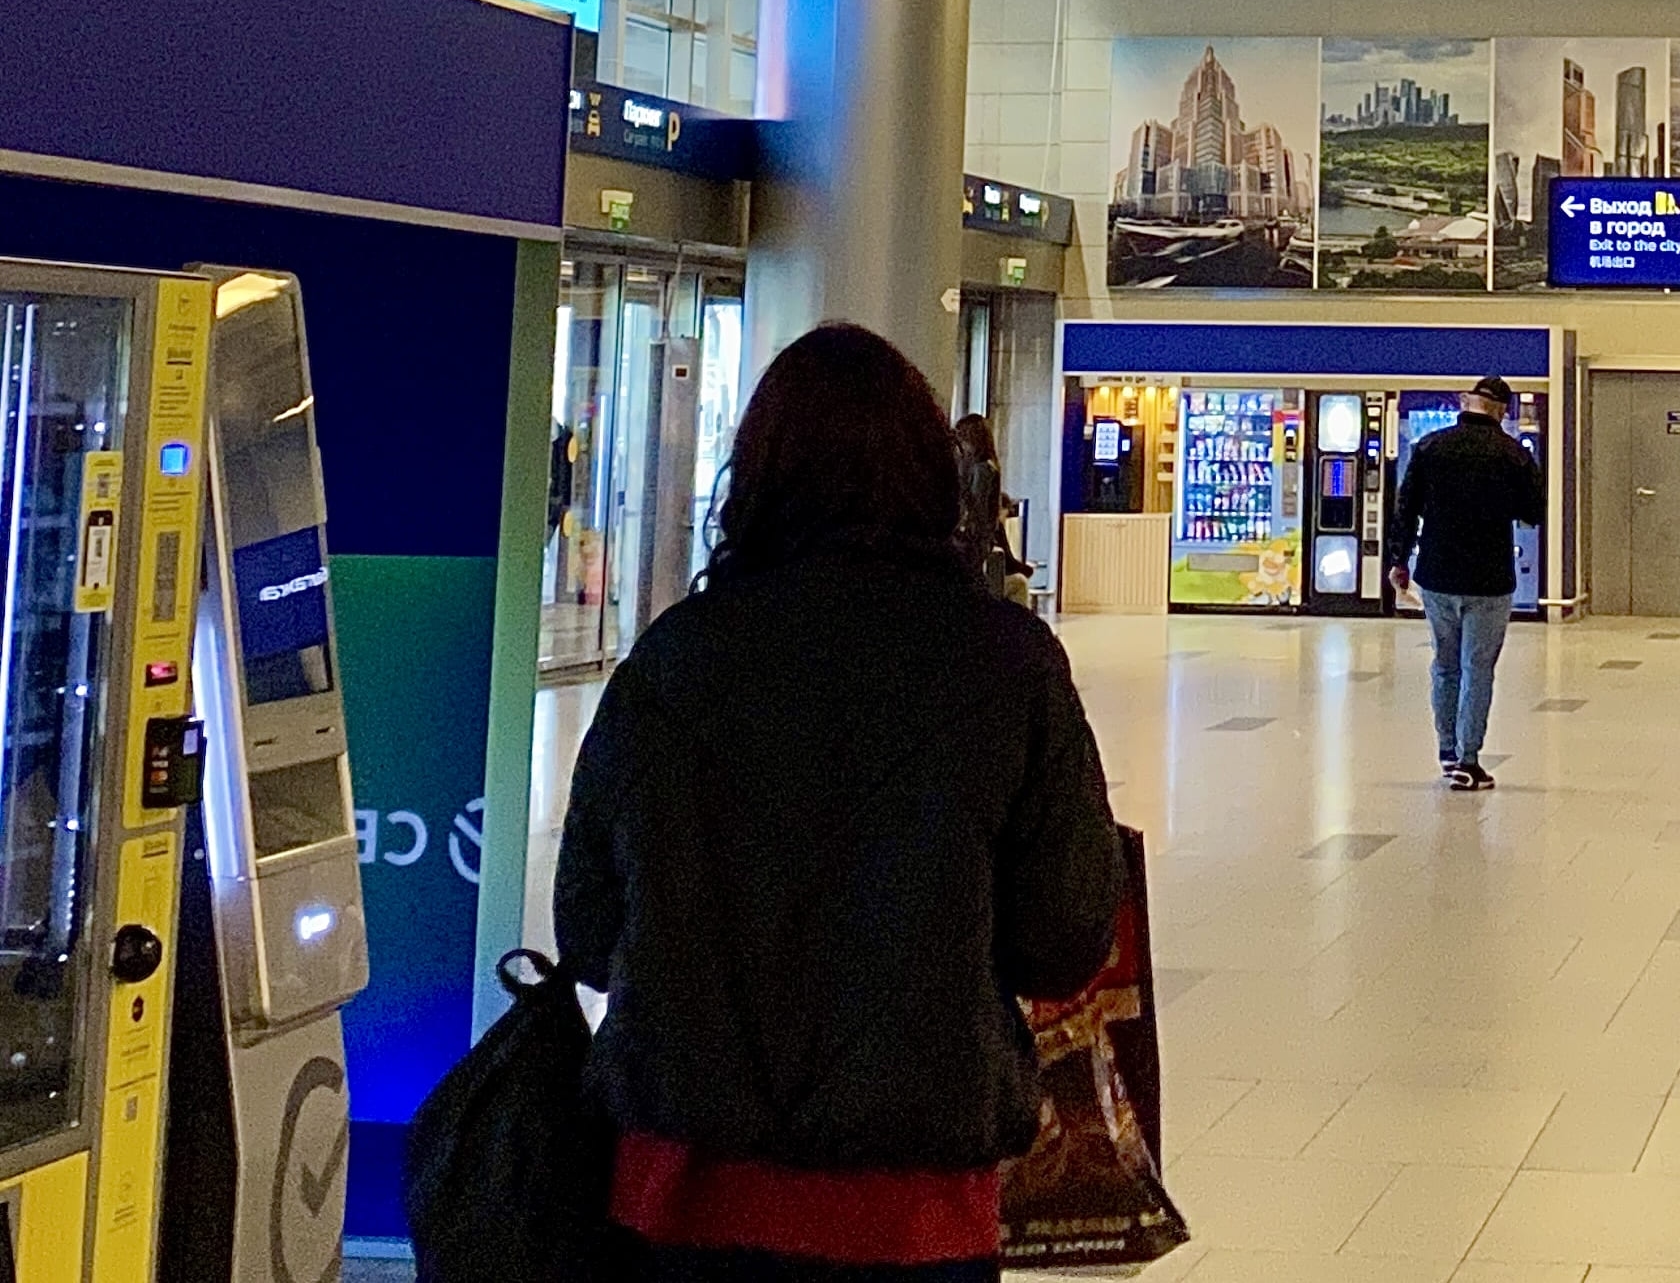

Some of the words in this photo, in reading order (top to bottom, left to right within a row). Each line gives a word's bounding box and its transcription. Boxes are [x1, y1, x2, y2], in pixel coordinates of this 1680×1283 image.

[1590, 198, 1651, 215] Выход
[1590, 223, 1601, 235] в
[1607, 221, 1666, 237] город
[1590, 240, 1611, 252] Exit
[1615, 240, 1630, 252] to
[1634, 240, 1657, 252] the
